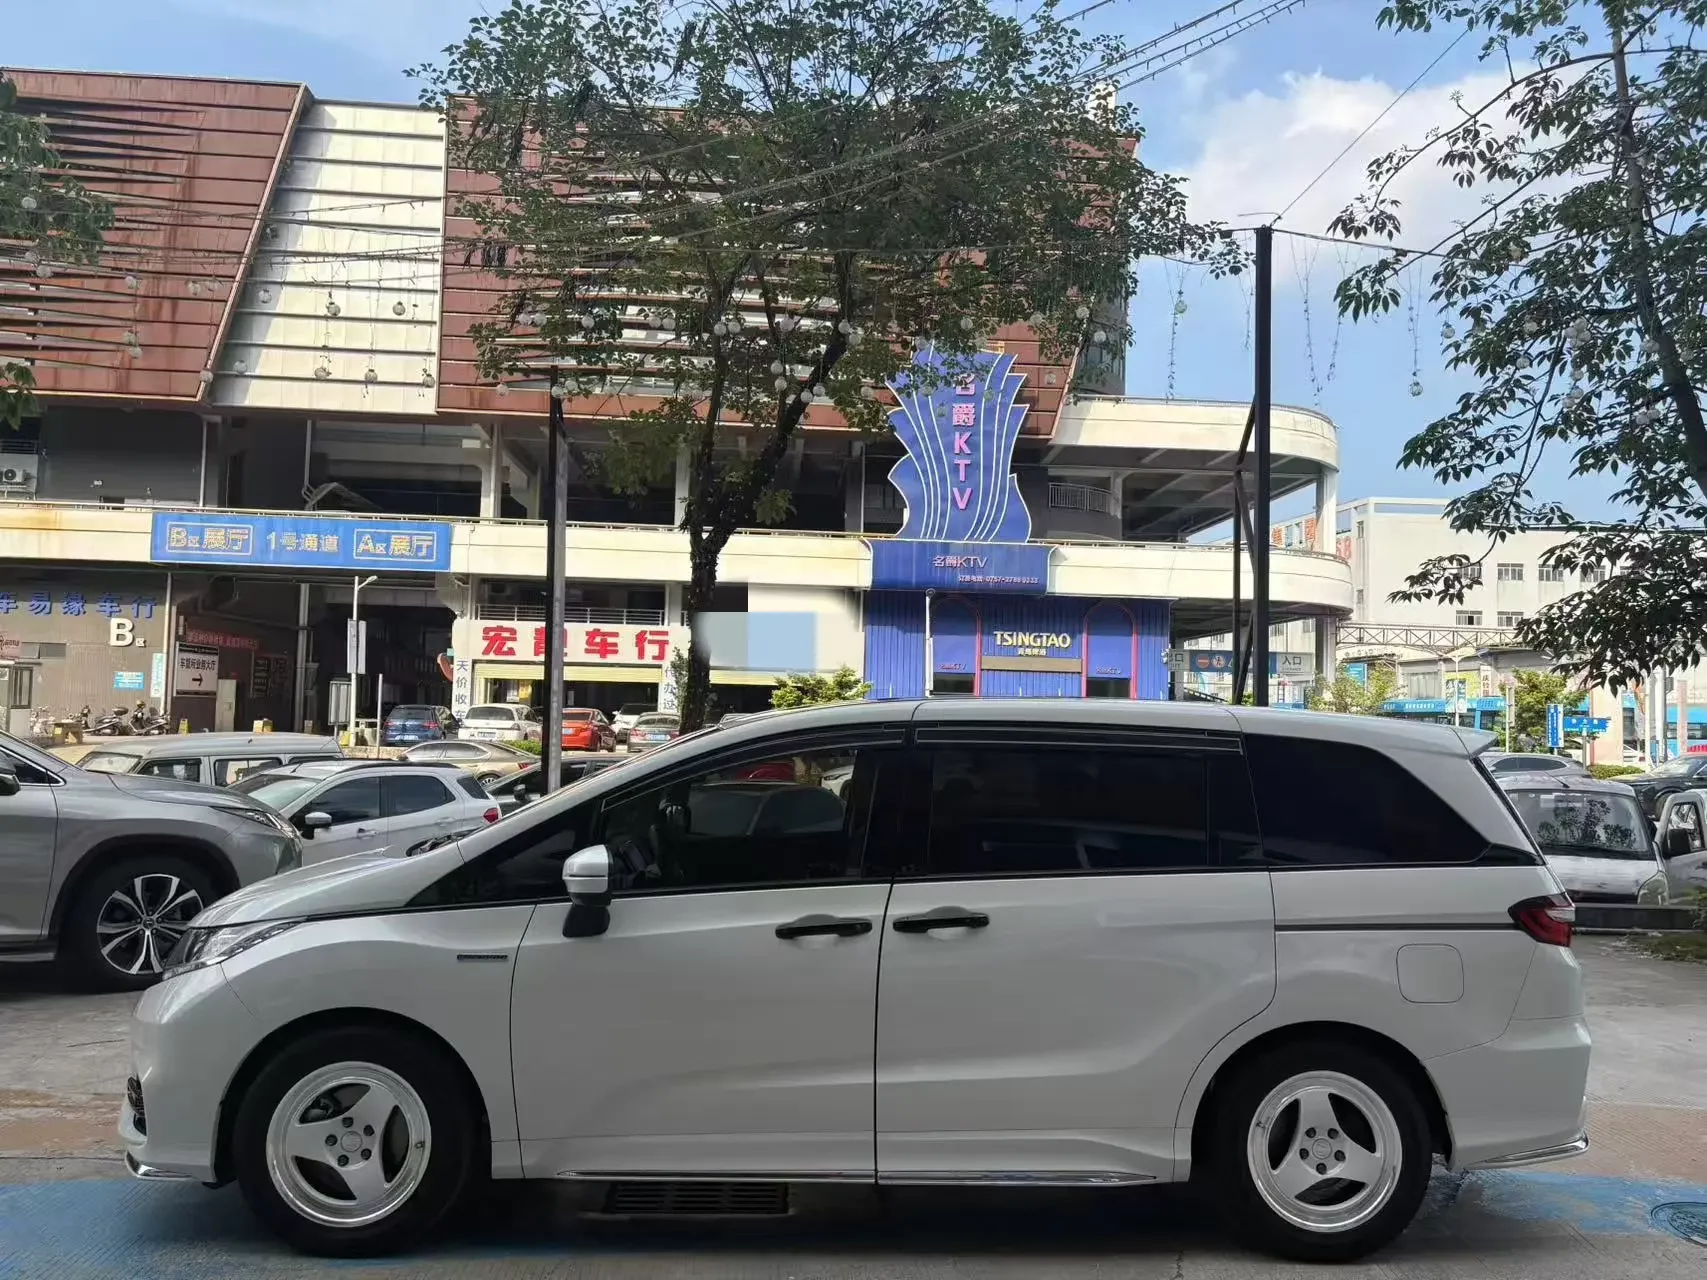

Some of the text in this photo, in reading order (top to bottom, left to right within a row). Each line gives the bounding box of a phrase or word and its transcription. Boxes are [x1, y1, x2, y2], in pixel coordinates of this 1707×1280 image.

[266, 531, 340, 553] 1号通道
[933, 555, 988, 568] 名爵KTV
[993, 631, 1071, 648] TSINGTAO
[1281, 655, 1302, 665] 入口
